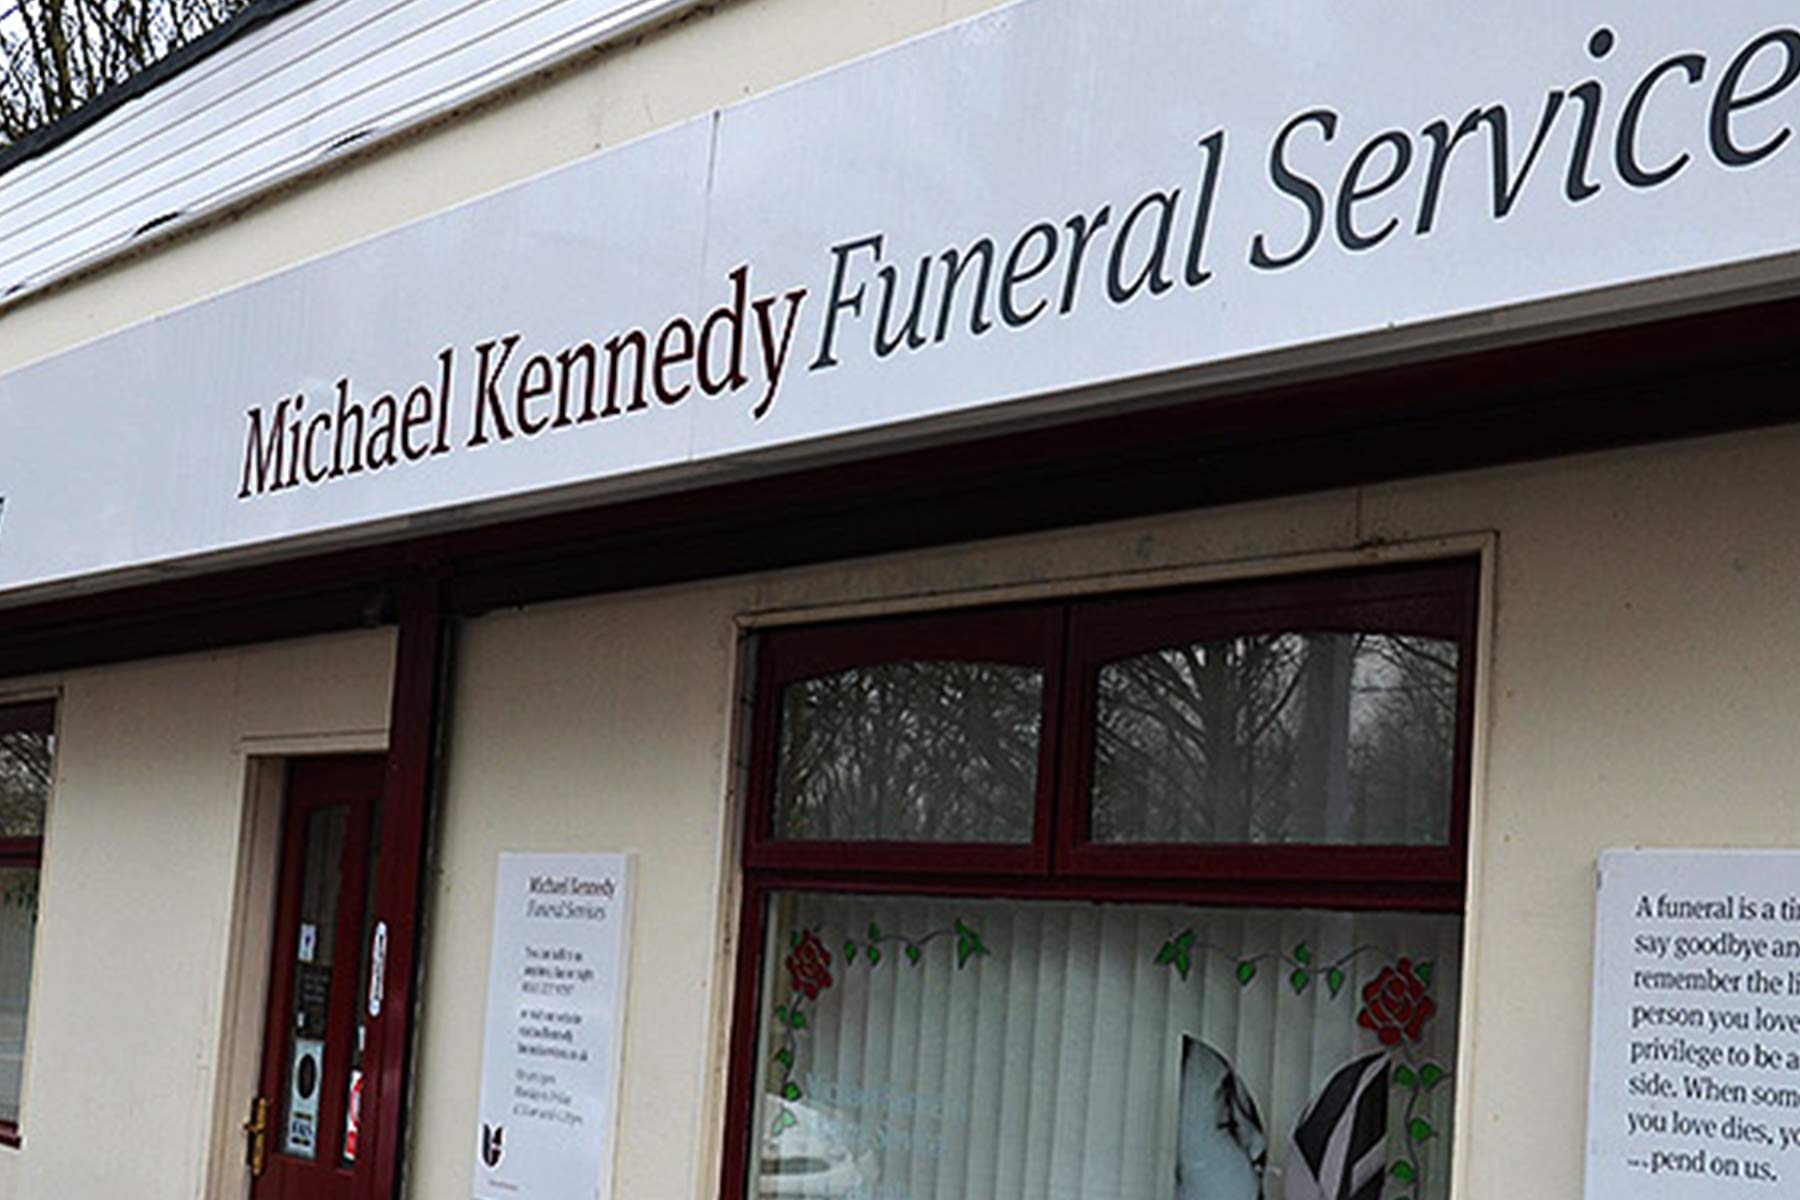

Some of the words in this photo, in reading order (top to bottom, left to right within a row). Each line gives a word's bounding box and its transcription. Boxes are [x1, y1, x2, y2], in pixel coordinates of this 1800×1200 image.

[237, 348, 453, 499] Michael
[466, 265, 808, 447] Kennedy
[808, 130, 1224, 371] Funeral
[1249, 28, 1800, 270] Service
[1635, 895, 1653, 919] A
[1656, 894, 1734, 920] funeral
[1738, 895, 1758, 920] is
[1761, 901, 1776, 921] a
[1634, 936, 1671, 960] say
[1673, 932, 1768, 962] goodbye
[1633, 967, 1741, 993] remember
[1747, 969, 1783, 996] the
[1631, 1005, 1704, 1030] person
[1708, 1010, 1750, 1034] you
[1630, 1037, 1724, 1068] privilege
[1727, 1046, 1750, 1067] to
[1754, 1043, 1783, 1070] be
[1628, 1072, 1678, 1099] side.
[1682, 1075, 1747, 1103] When
[1627, 1112, 1667, 1136] you
[1672, 1110, 1717, 1139] love
[1709, 1156, 1740, 1177] on
[1744, 1161, 1777, 1182] us.
